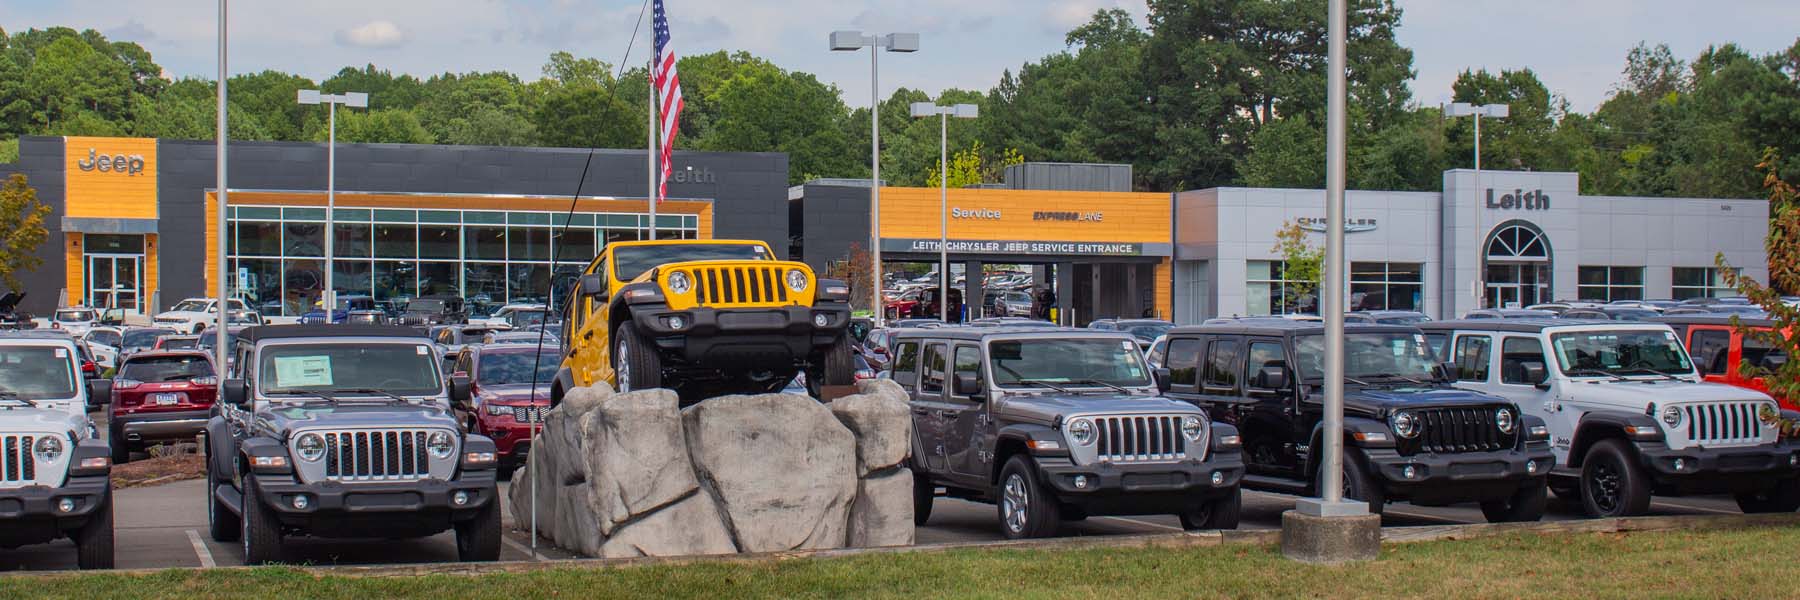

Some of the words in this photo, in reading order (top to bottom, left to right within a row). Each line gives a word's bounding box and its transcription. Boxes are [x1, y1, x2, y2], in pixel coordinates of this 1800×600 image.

[79, 148, 144, 176] Jeep
[1486, 188, 1550, 210] Leith
[952, 207, 1001, 219] Service
[1297, 217, 1377, 225] CHRLER
[913, 241, 942, 250] LEITH
[946, 242, 999, 251] CHRYSLER
[1003, 242, 1028, 252] JEEP
[1032, 243, 1074, 253] SERVICE
[1078, 244, 1132, 253] ENTRANCE
